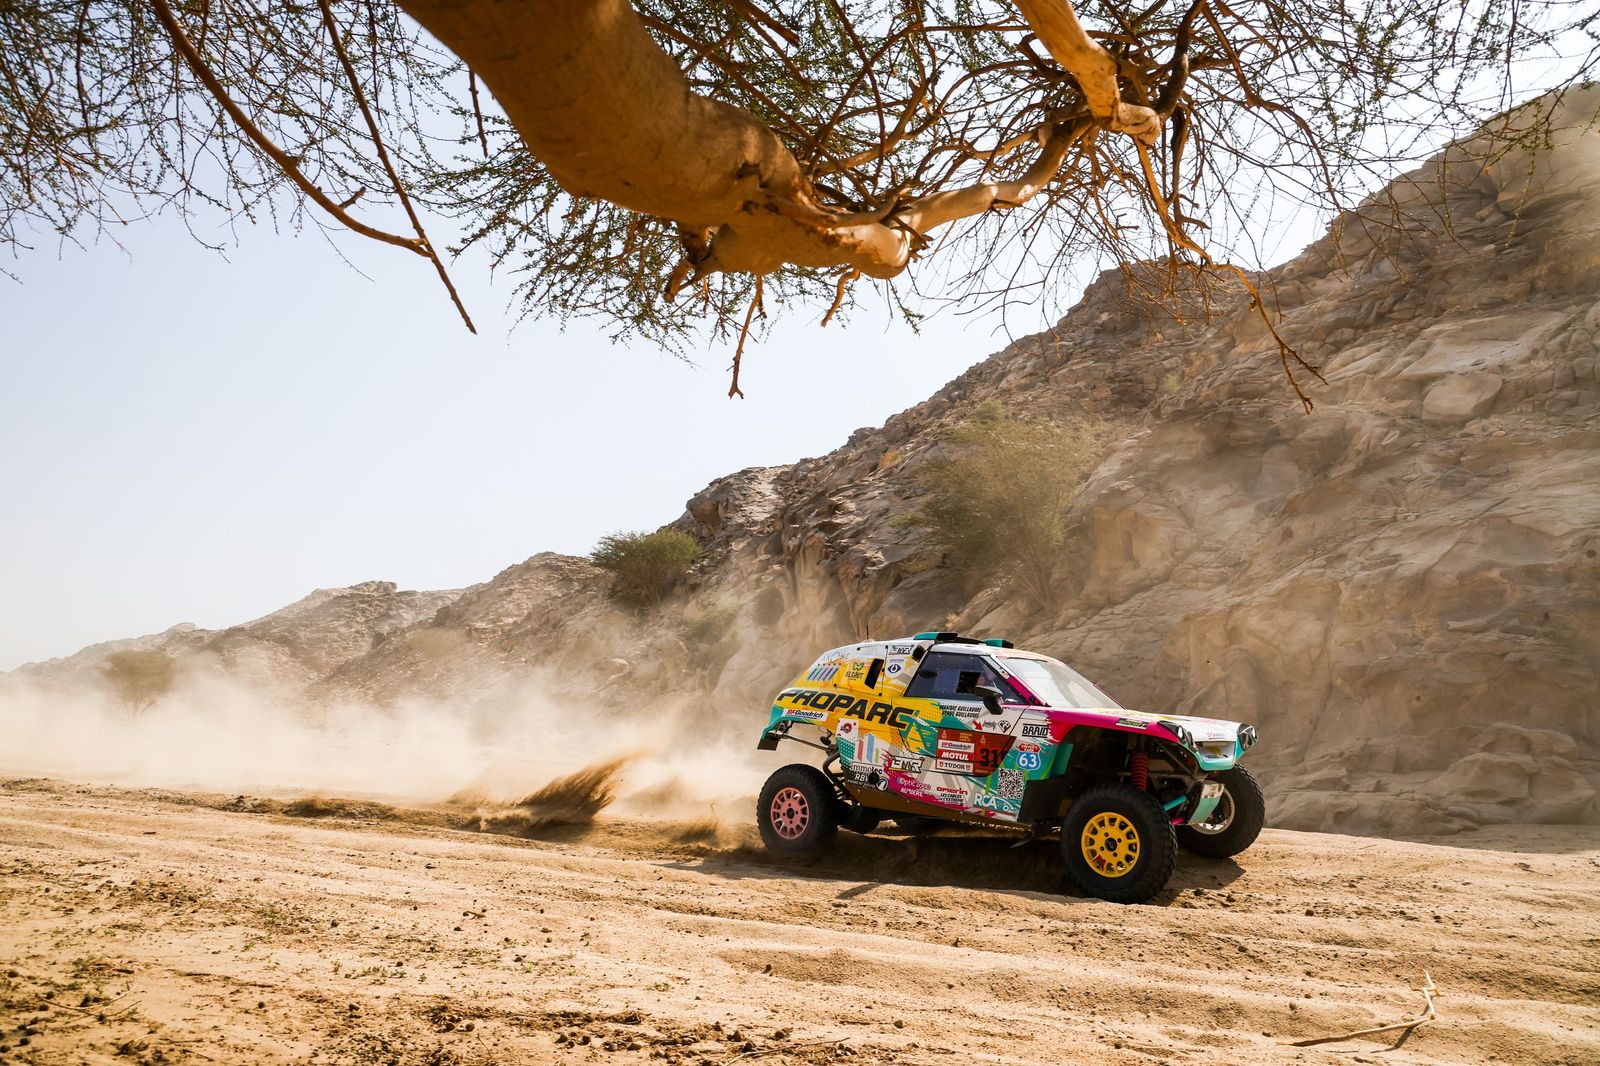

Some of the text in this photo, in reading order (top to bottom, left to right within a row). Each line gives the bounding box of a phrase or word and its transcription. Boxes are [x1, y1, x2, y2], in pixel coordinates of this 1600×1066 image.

[777, 689, 914, 729] PROPARC
[786, 709, 824, 719] BFGoodrich
[1022, 725, 1048, 737] BRAID
[941, 742, 972, 750] BFGoodrich
[941, 751, 969, 761] MOTUL
[1019, 753, 1037, 768] 63
[944, 762, 966, 770] TUDOR
[900, 778, 931, 790] Optic 2000
[936, 786, 968, 795] omerin
[974, 793, 997, 809] RCA
